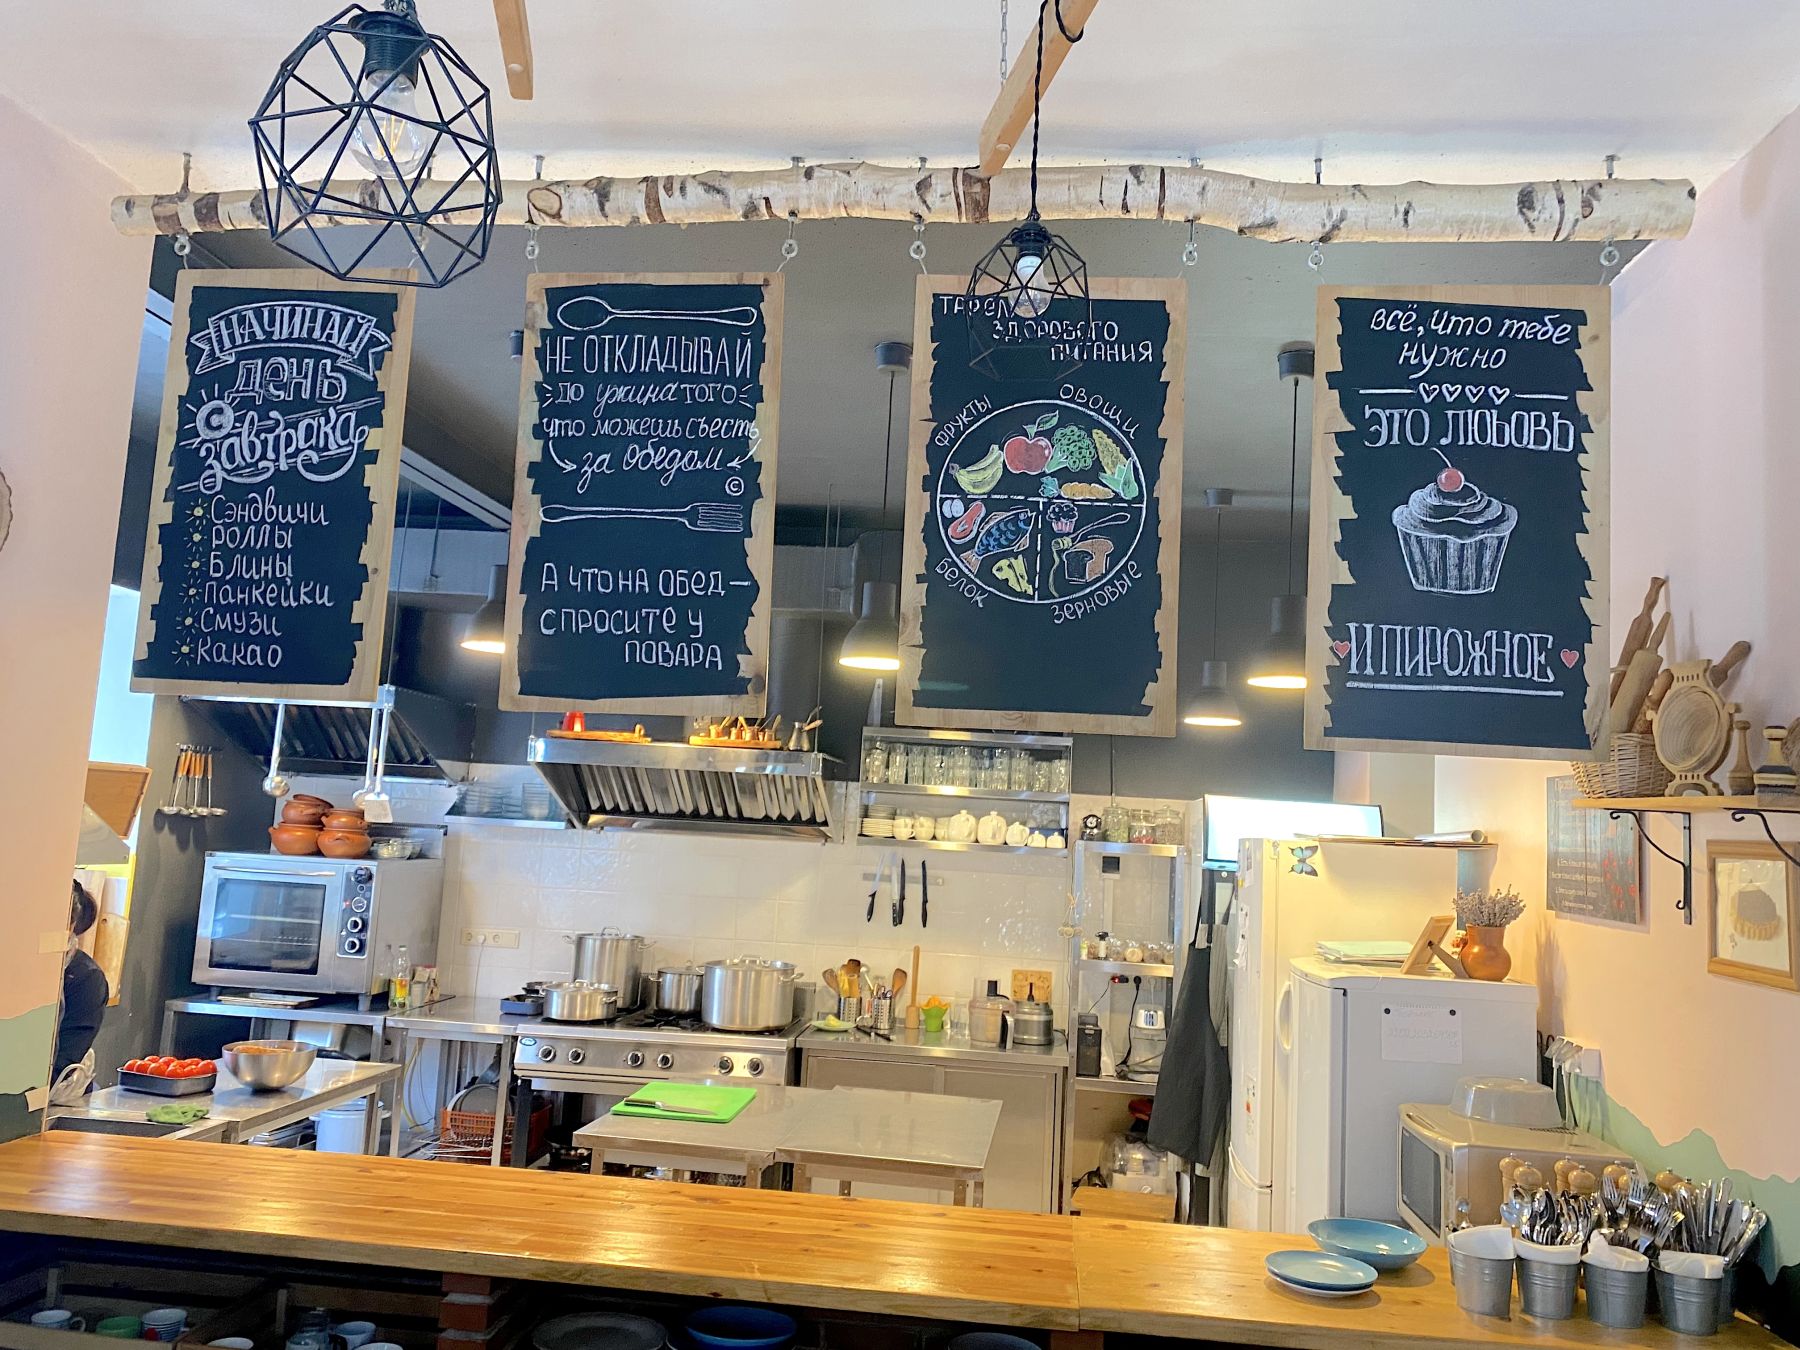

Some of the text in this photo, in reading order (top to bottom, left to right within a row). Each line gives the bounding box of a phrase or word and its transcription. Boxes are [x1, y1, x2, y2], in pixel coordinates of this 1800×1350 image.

[218, 305, 372, 352] НАЧИНАЙ
[1498, 314, 1571, 345] тебе
[545, 331, 752, 379] НЕ ОТКЛАДЫВАЙ
[593, 380, 678, 418] ужина
[1059, 384, 1141, 440] ОВОЩИ
[542, 417, 760, 440] что можешь съесть
[1363, 405, 1430, 448] ЭТО
[577, 452, 615, 494] за
[211, 486, 329, 526] Сэндвичи
[209, 552, 293, 580] Блины
[541, 563, 558, 593] А
[204, 577, 335, 607] Панкейки
[201, 607, 282, 636] Смузи
[197, 635, 282, 668] Какао
[625, 640, 723, 671] ПОВАРА
[1345, 622, 1555, 683] И ПИРОЖНОЕ
